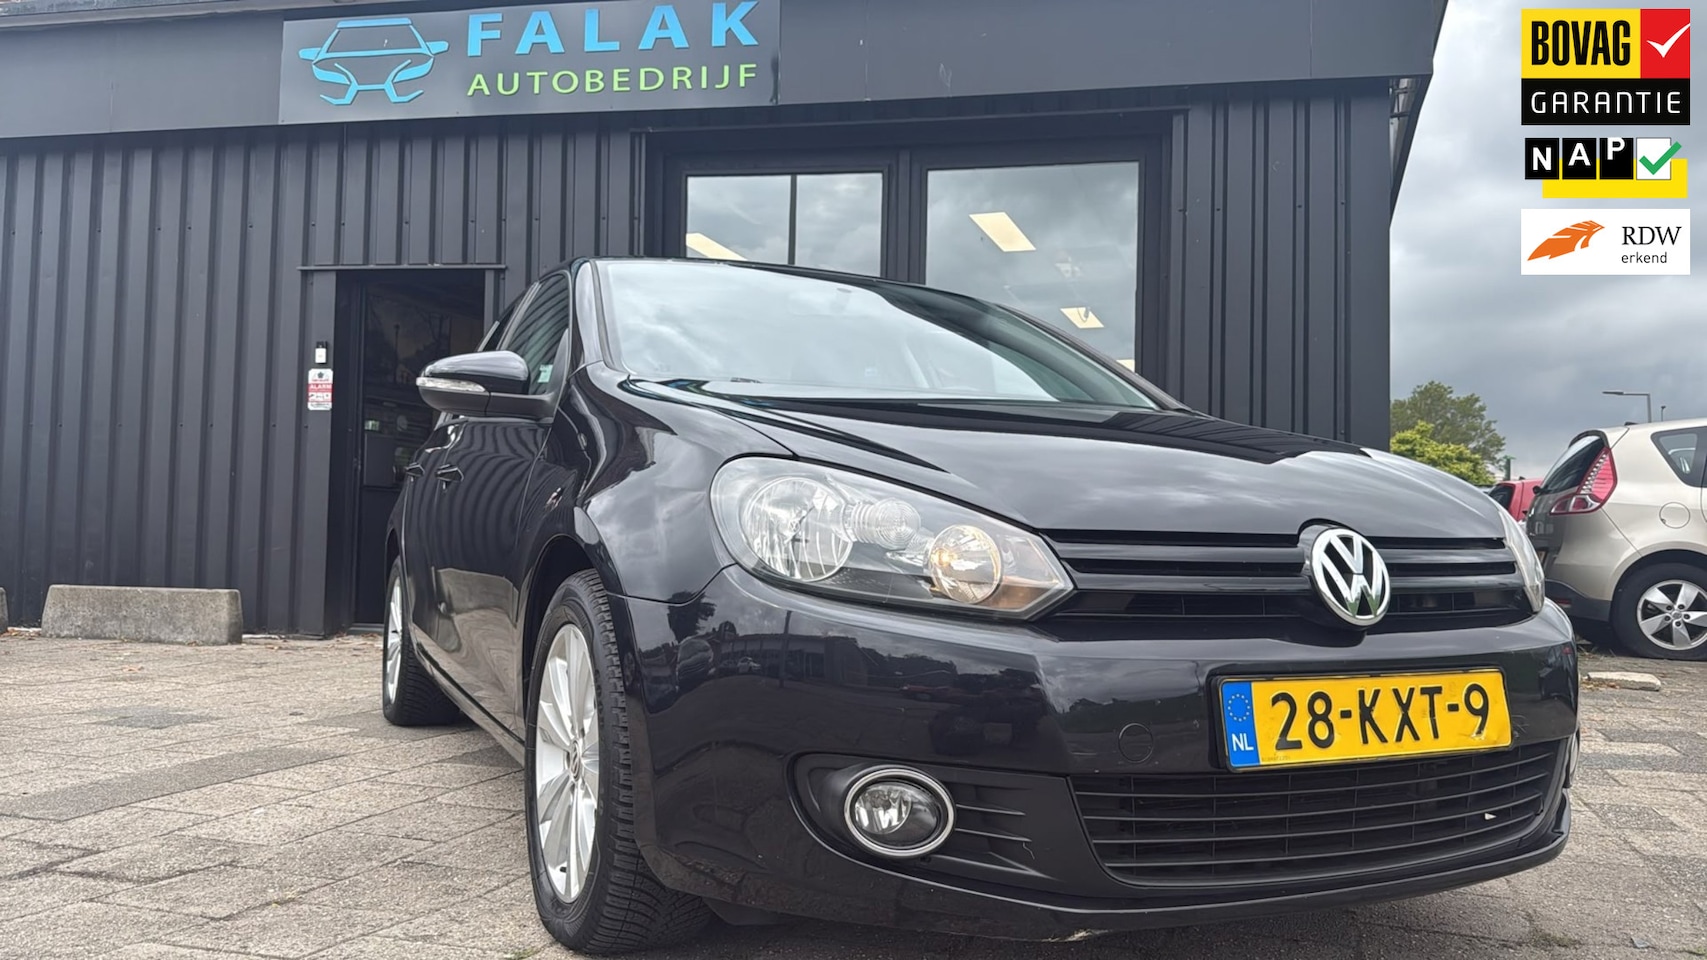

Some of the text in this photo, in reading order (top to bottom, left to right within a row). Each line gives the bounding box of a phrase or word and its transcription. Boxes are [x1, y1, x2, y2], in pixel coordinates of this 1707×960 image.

[467, 1, 759, 56] FALAK
[467, 64, 757, 96] AUTOBEDRIJF
[1271, 683, 1489, 751] 28-KXT-9
[1232, 732, 1254, 752] NL
